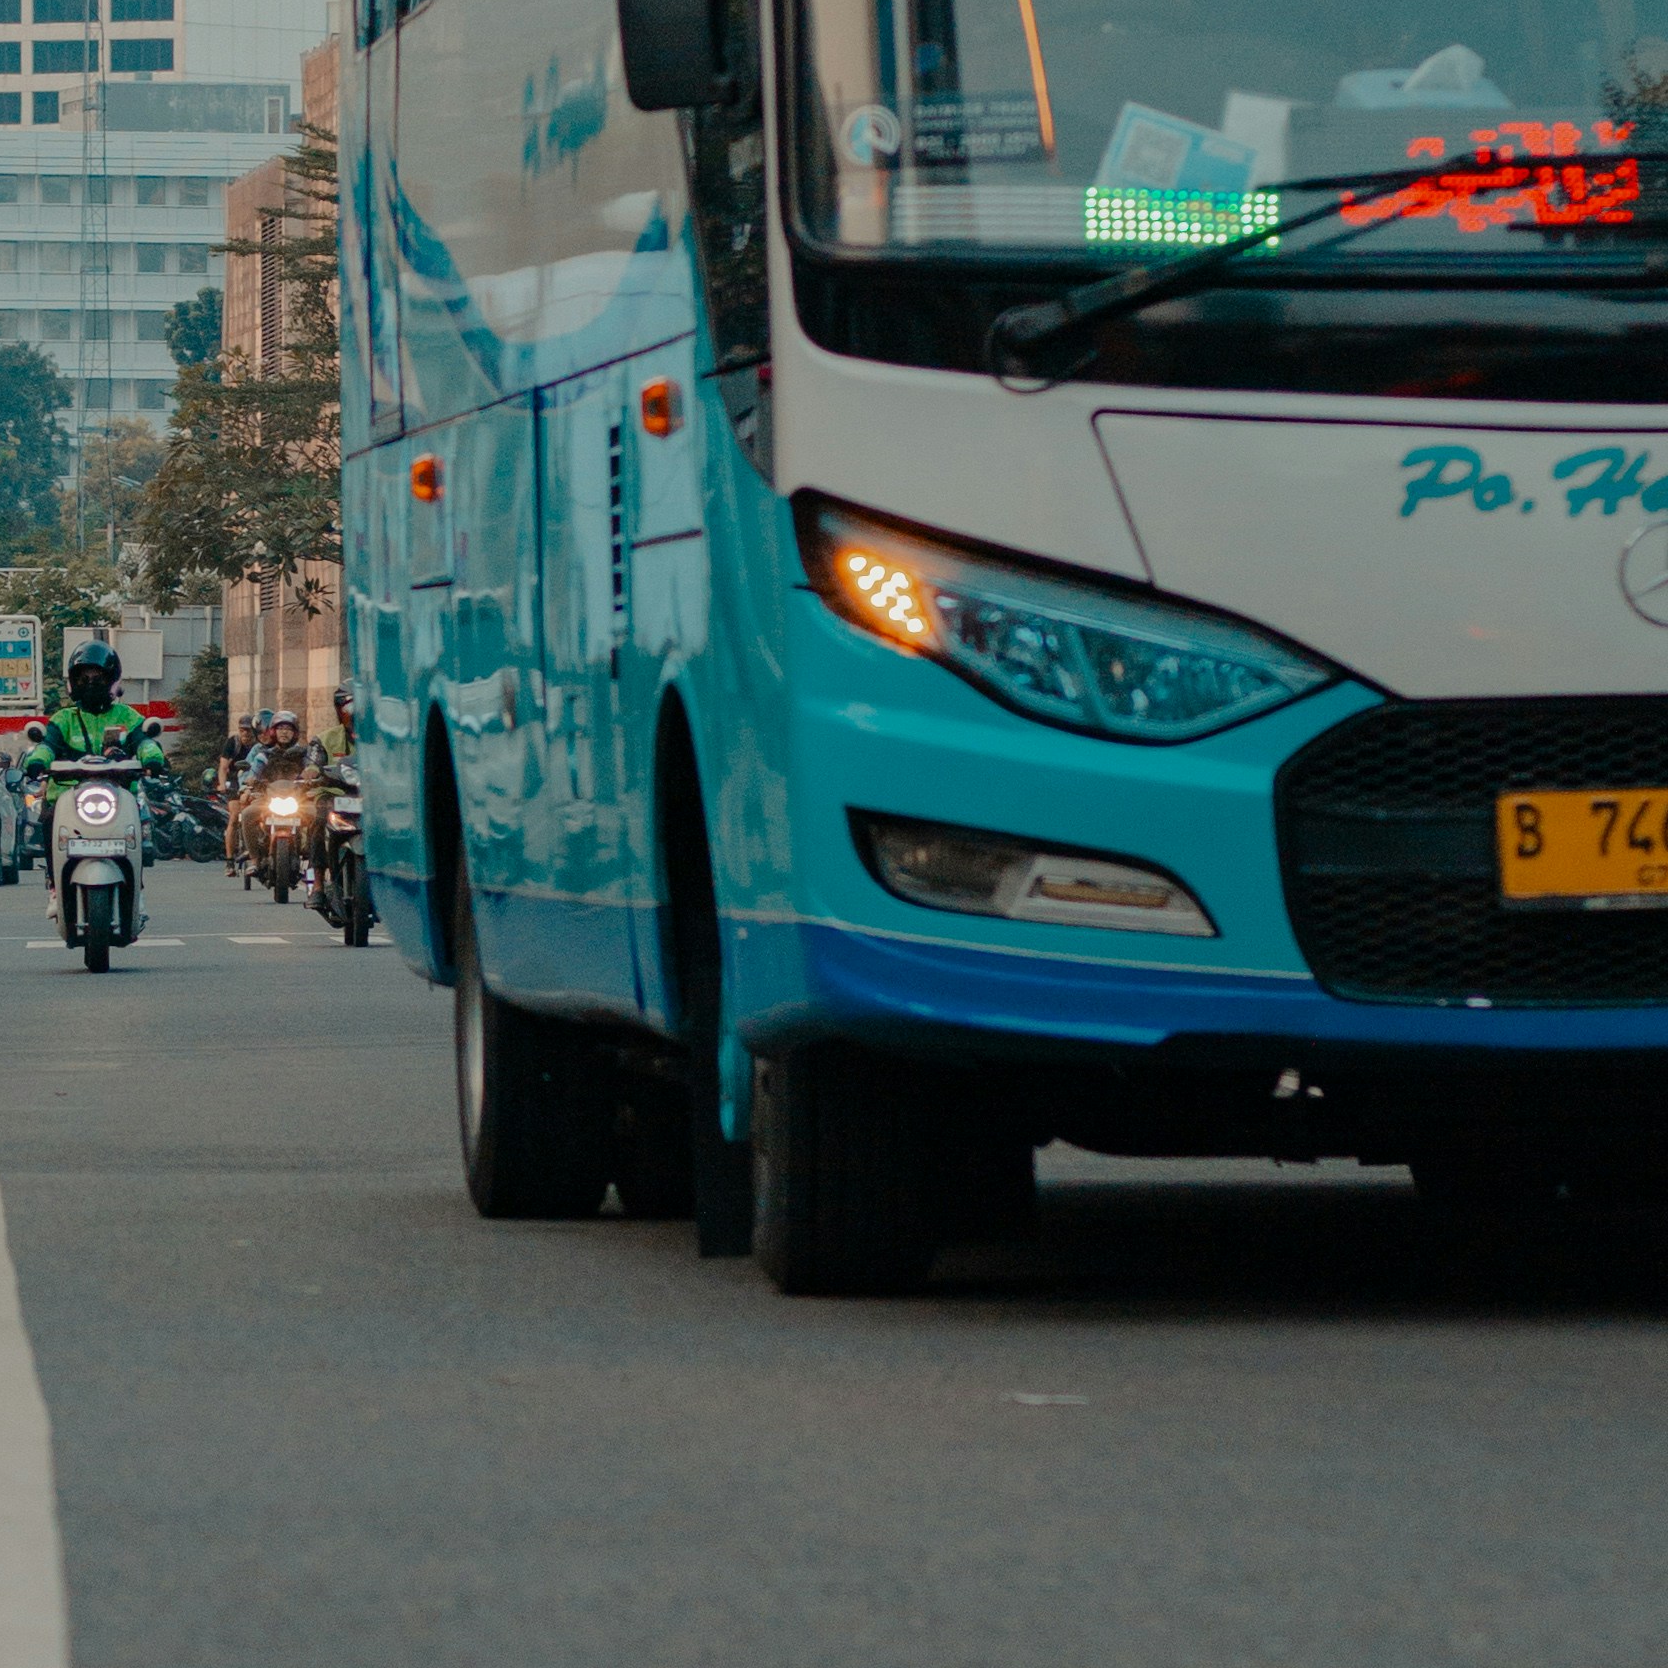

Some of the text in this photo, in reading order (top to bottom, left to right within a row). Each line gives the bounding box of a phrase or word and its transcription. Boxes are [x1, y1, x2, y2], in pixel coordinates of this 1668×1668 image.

[1400, 445, 1535, 518] Po.
[1516, 800, 1668, 859] B 74
